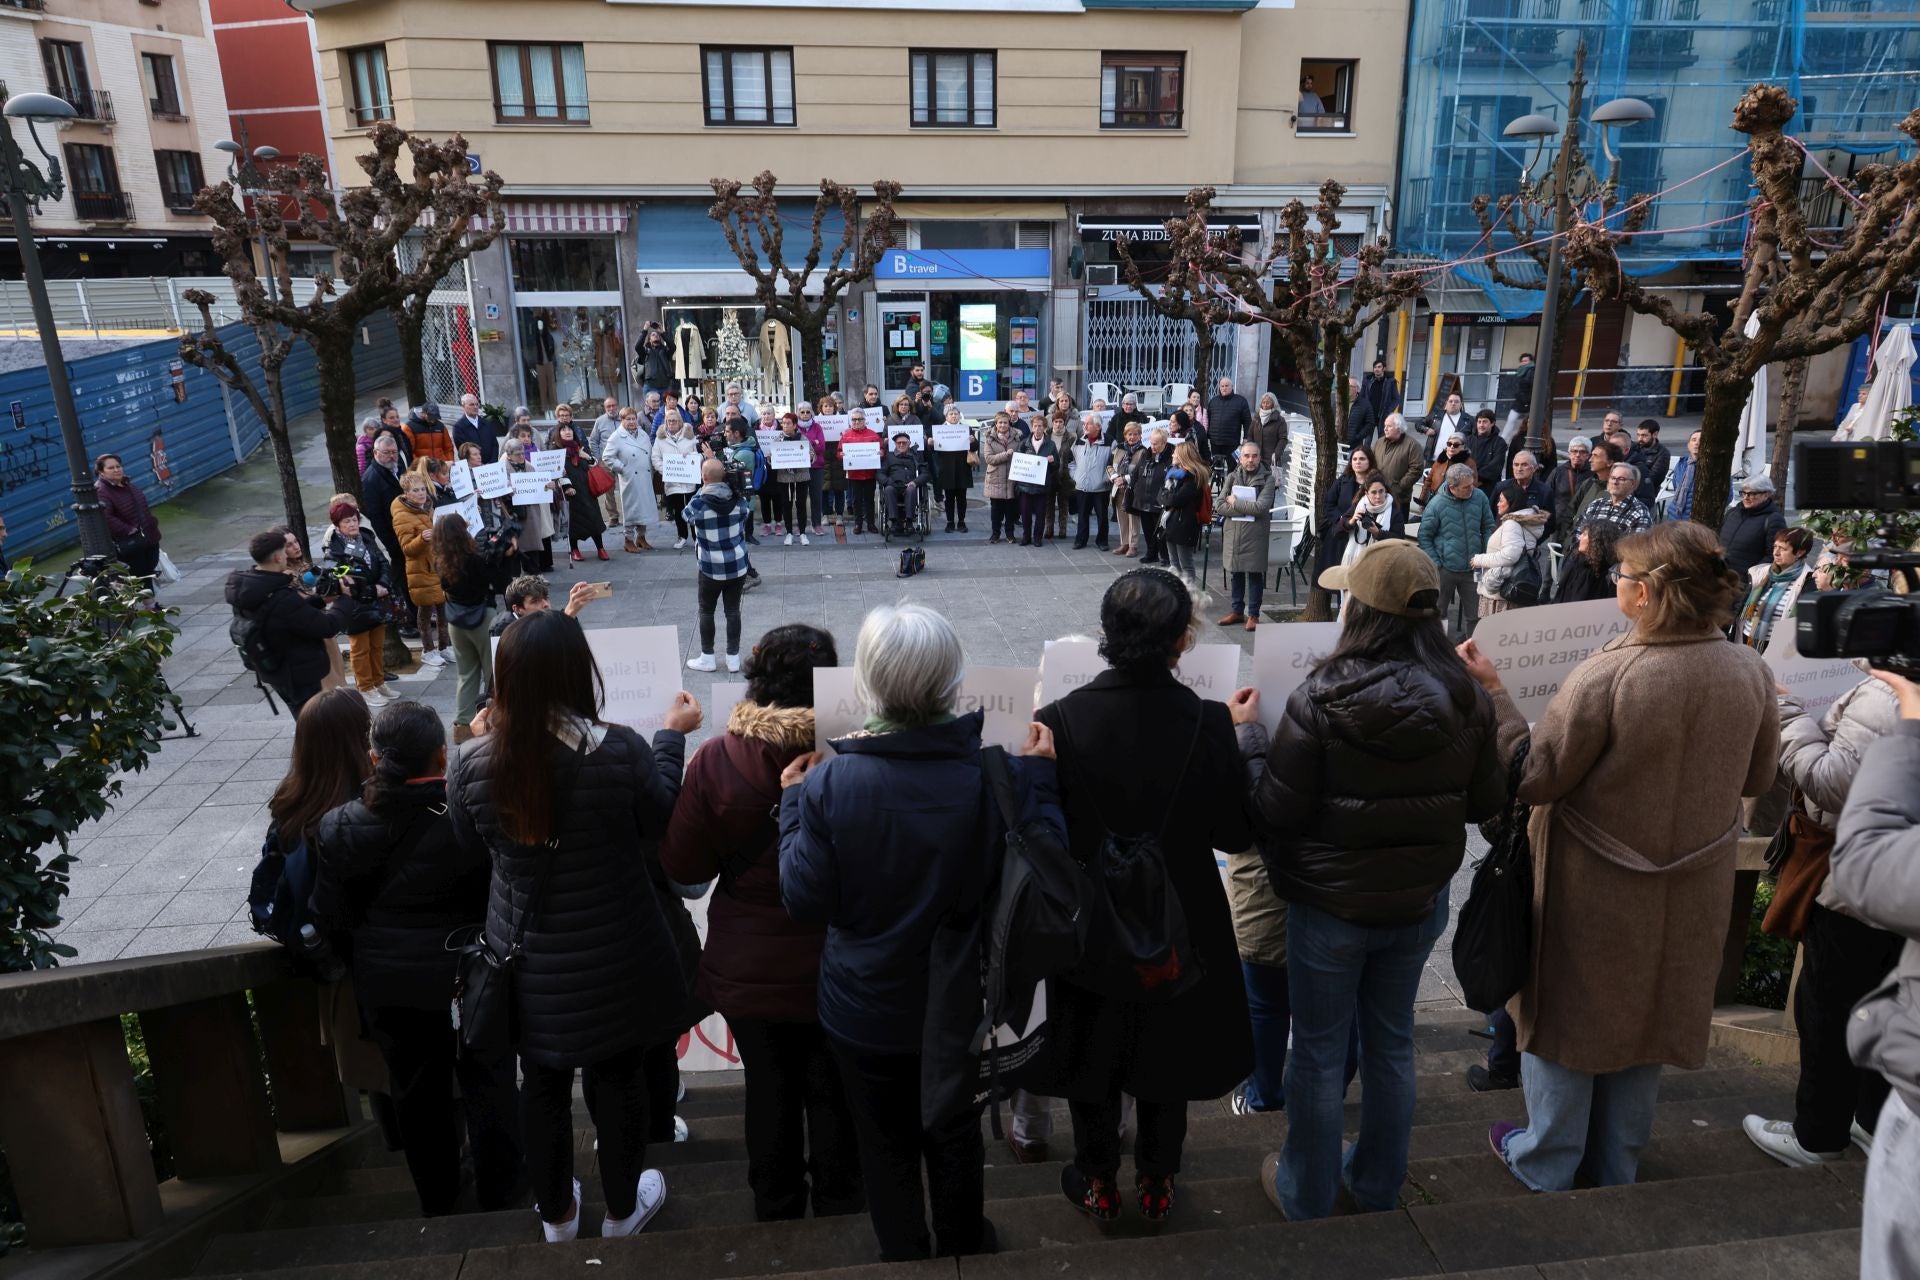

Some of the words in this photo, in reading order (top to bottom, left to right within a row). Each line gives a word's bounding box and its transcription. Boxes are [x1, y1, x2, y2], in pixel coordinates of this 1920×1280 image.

[1101, 230, 1139, 241] ZUMA
[894, 255, 907, 273] B
[909, 263, 938, 273] travel
[968, 375, 983, 396] B
